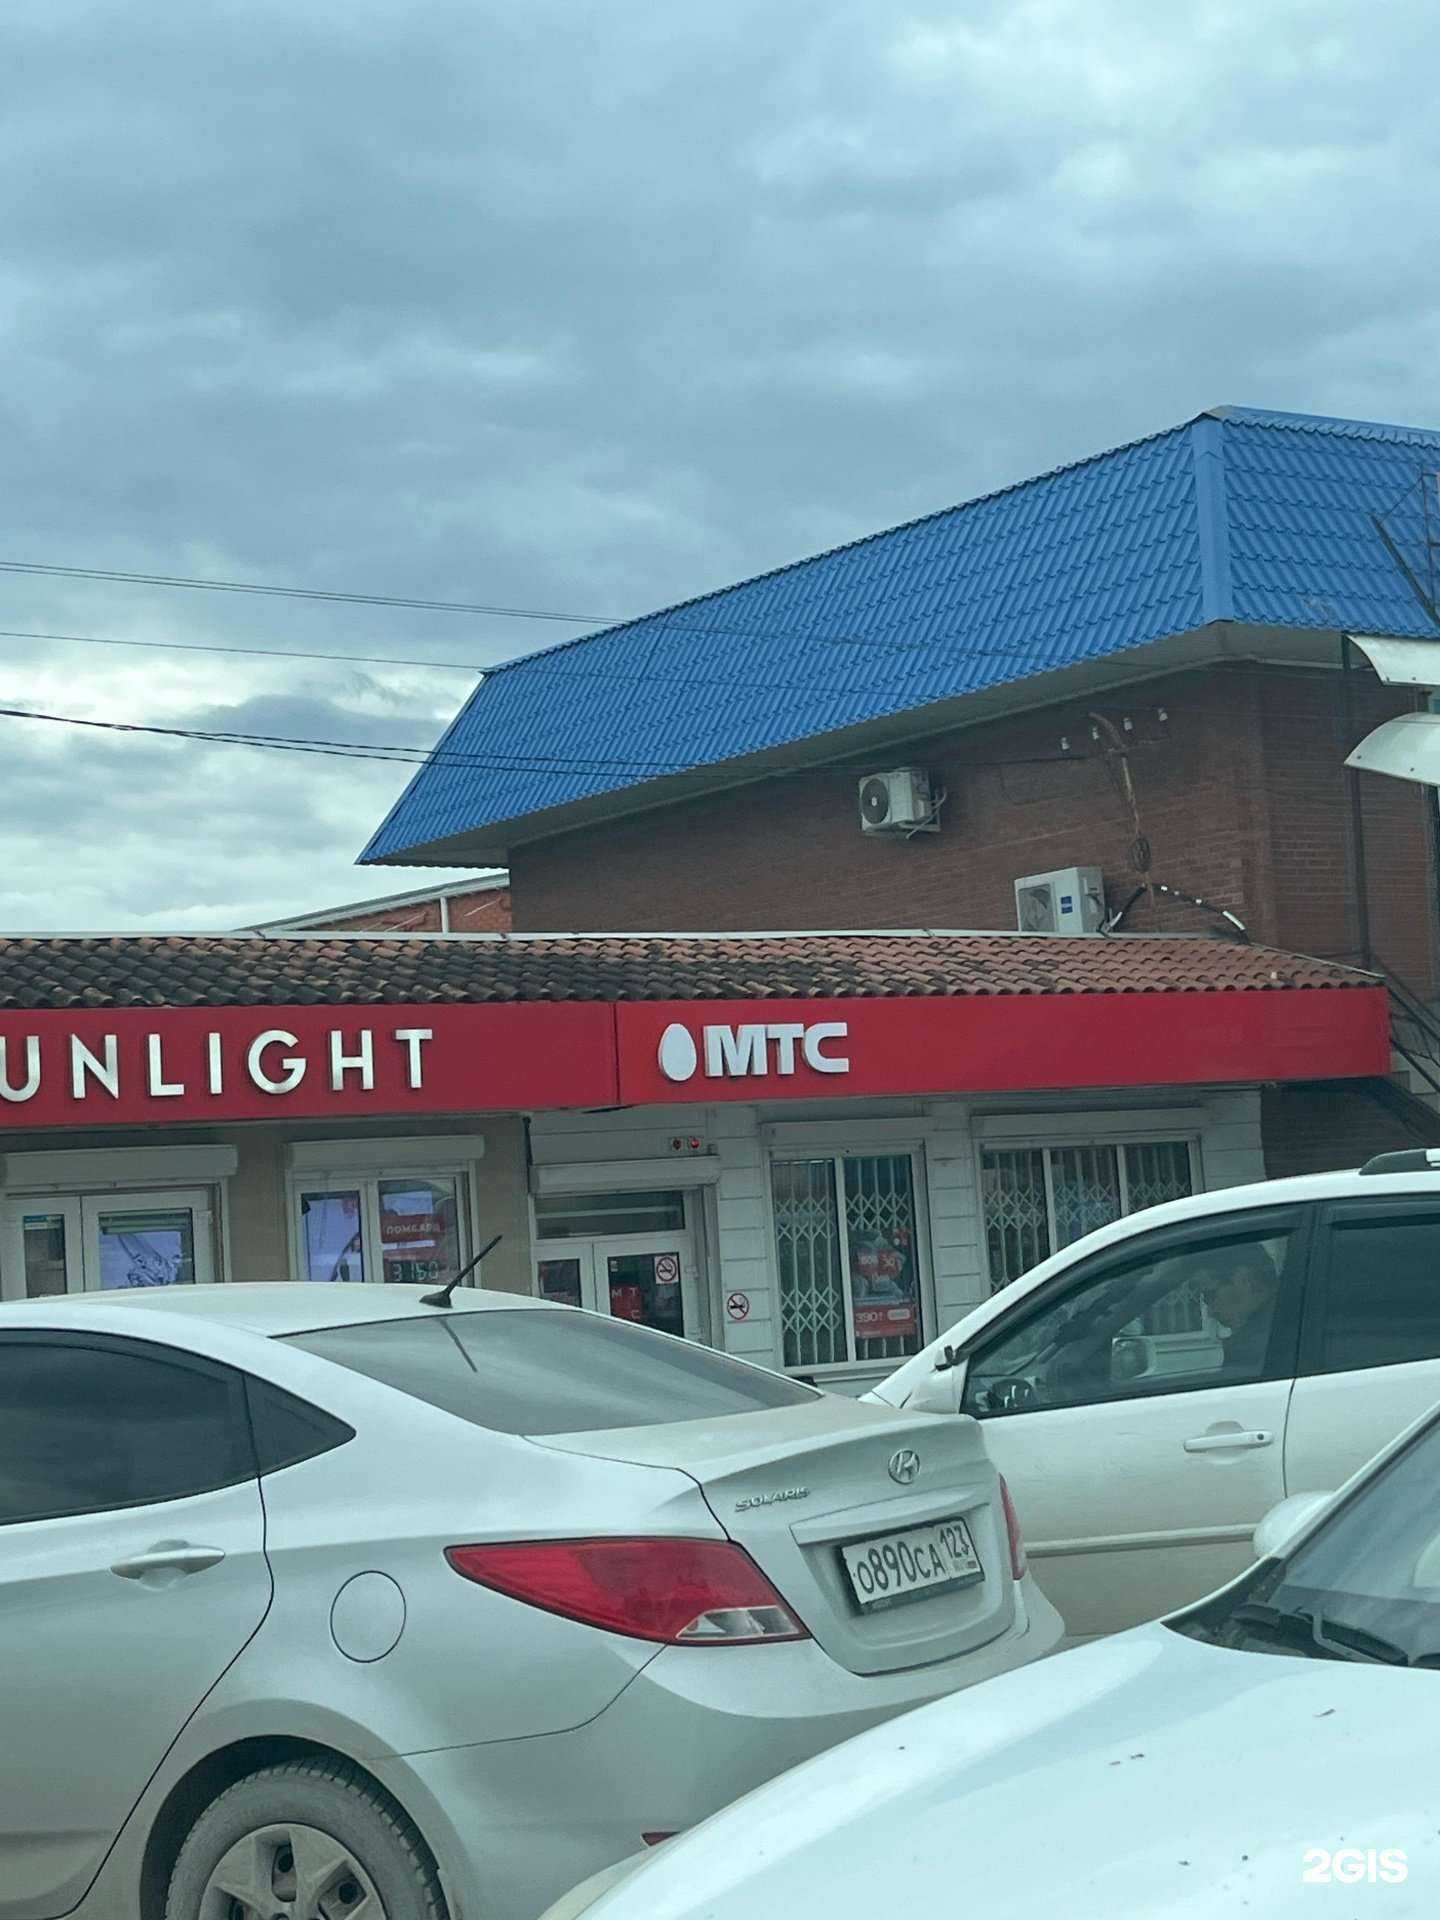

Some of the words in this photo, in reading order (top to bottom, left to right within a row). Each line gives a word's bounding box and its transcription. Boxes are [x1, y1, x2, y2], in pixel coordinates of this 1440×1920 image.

[0, 1028, 433, 1102] UNLIGHT
[704, 1022, 849, 1077] МТС
[735, 1486, 810, 1512] SOLARIS
[940, 1525, 970, 1559] 123
